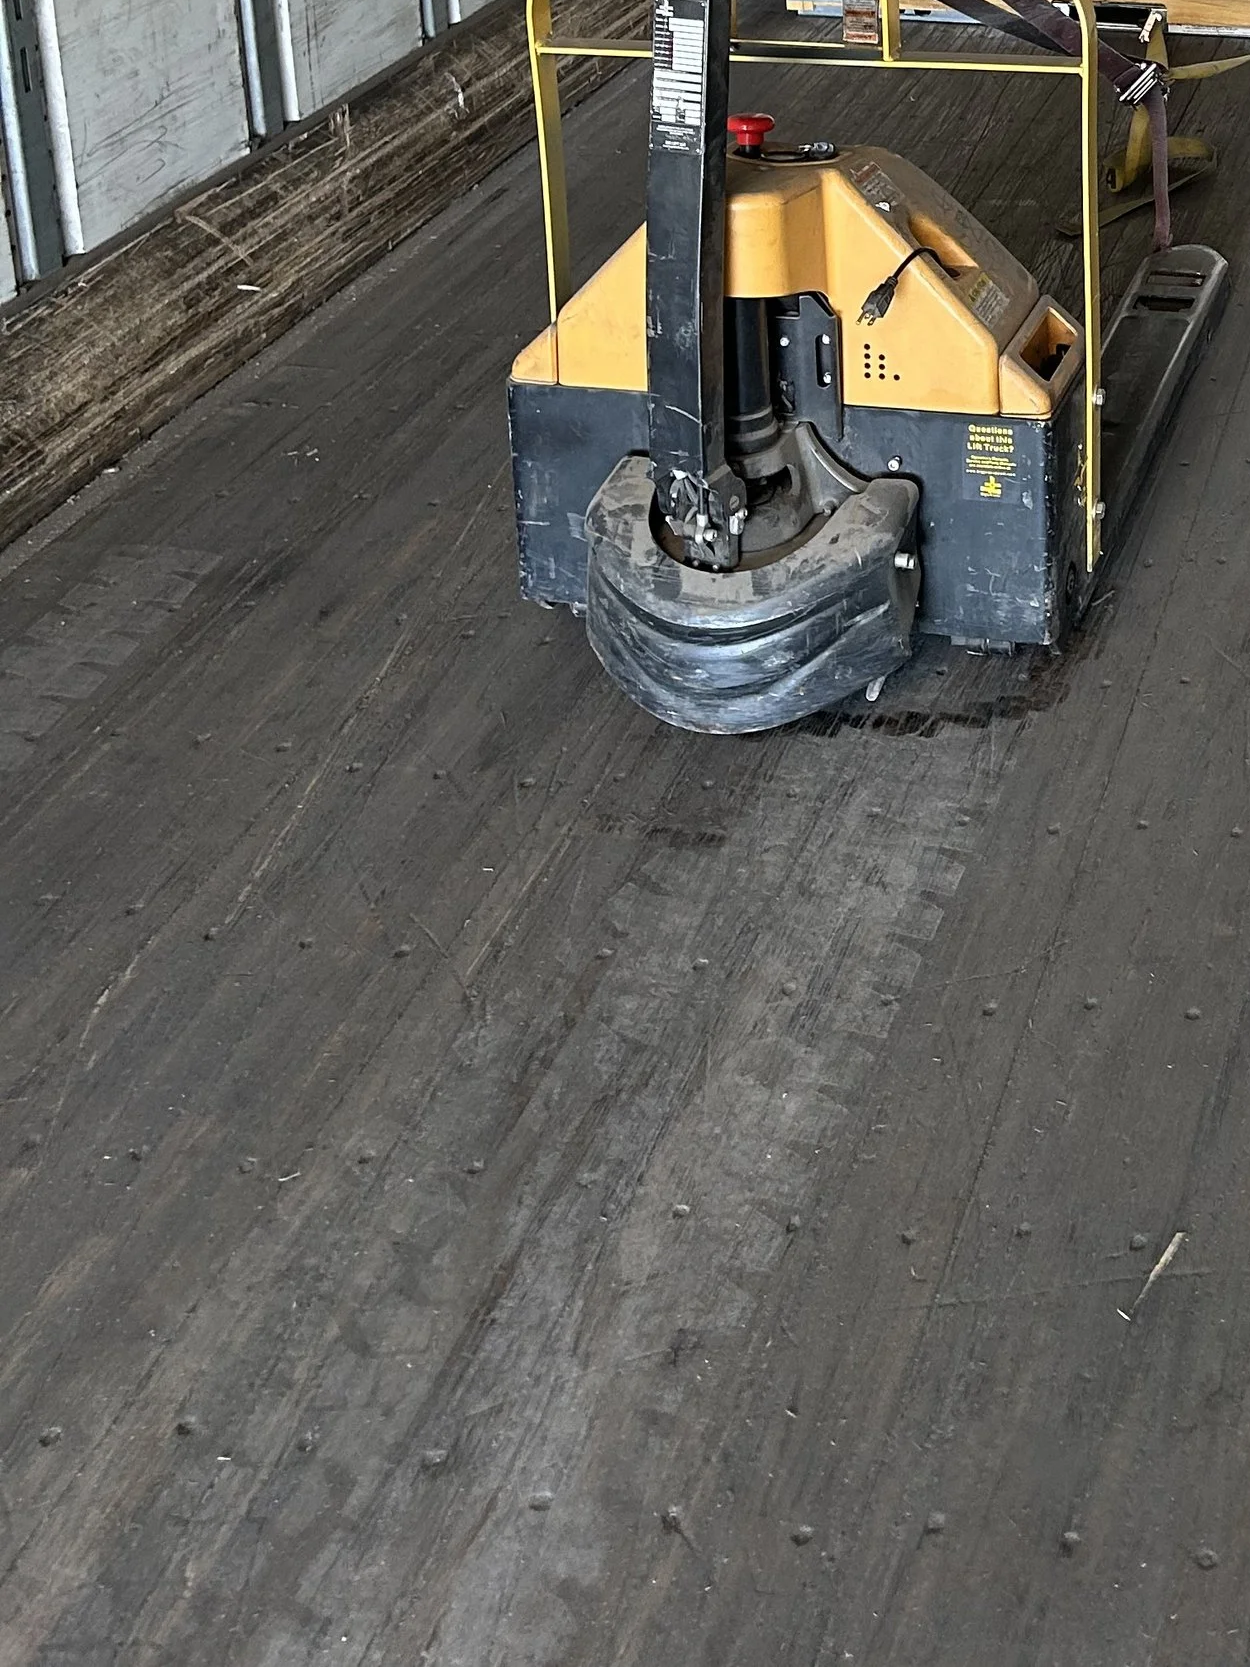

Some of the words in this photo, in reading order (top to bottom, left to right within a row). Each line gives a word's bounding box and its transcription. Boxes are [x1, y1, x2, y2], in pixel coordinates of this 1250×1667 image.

[968, 424, 1013, 436] Questions
[969, 434, 994, 443] about
[983, 443, 1014, 453] Truck?
